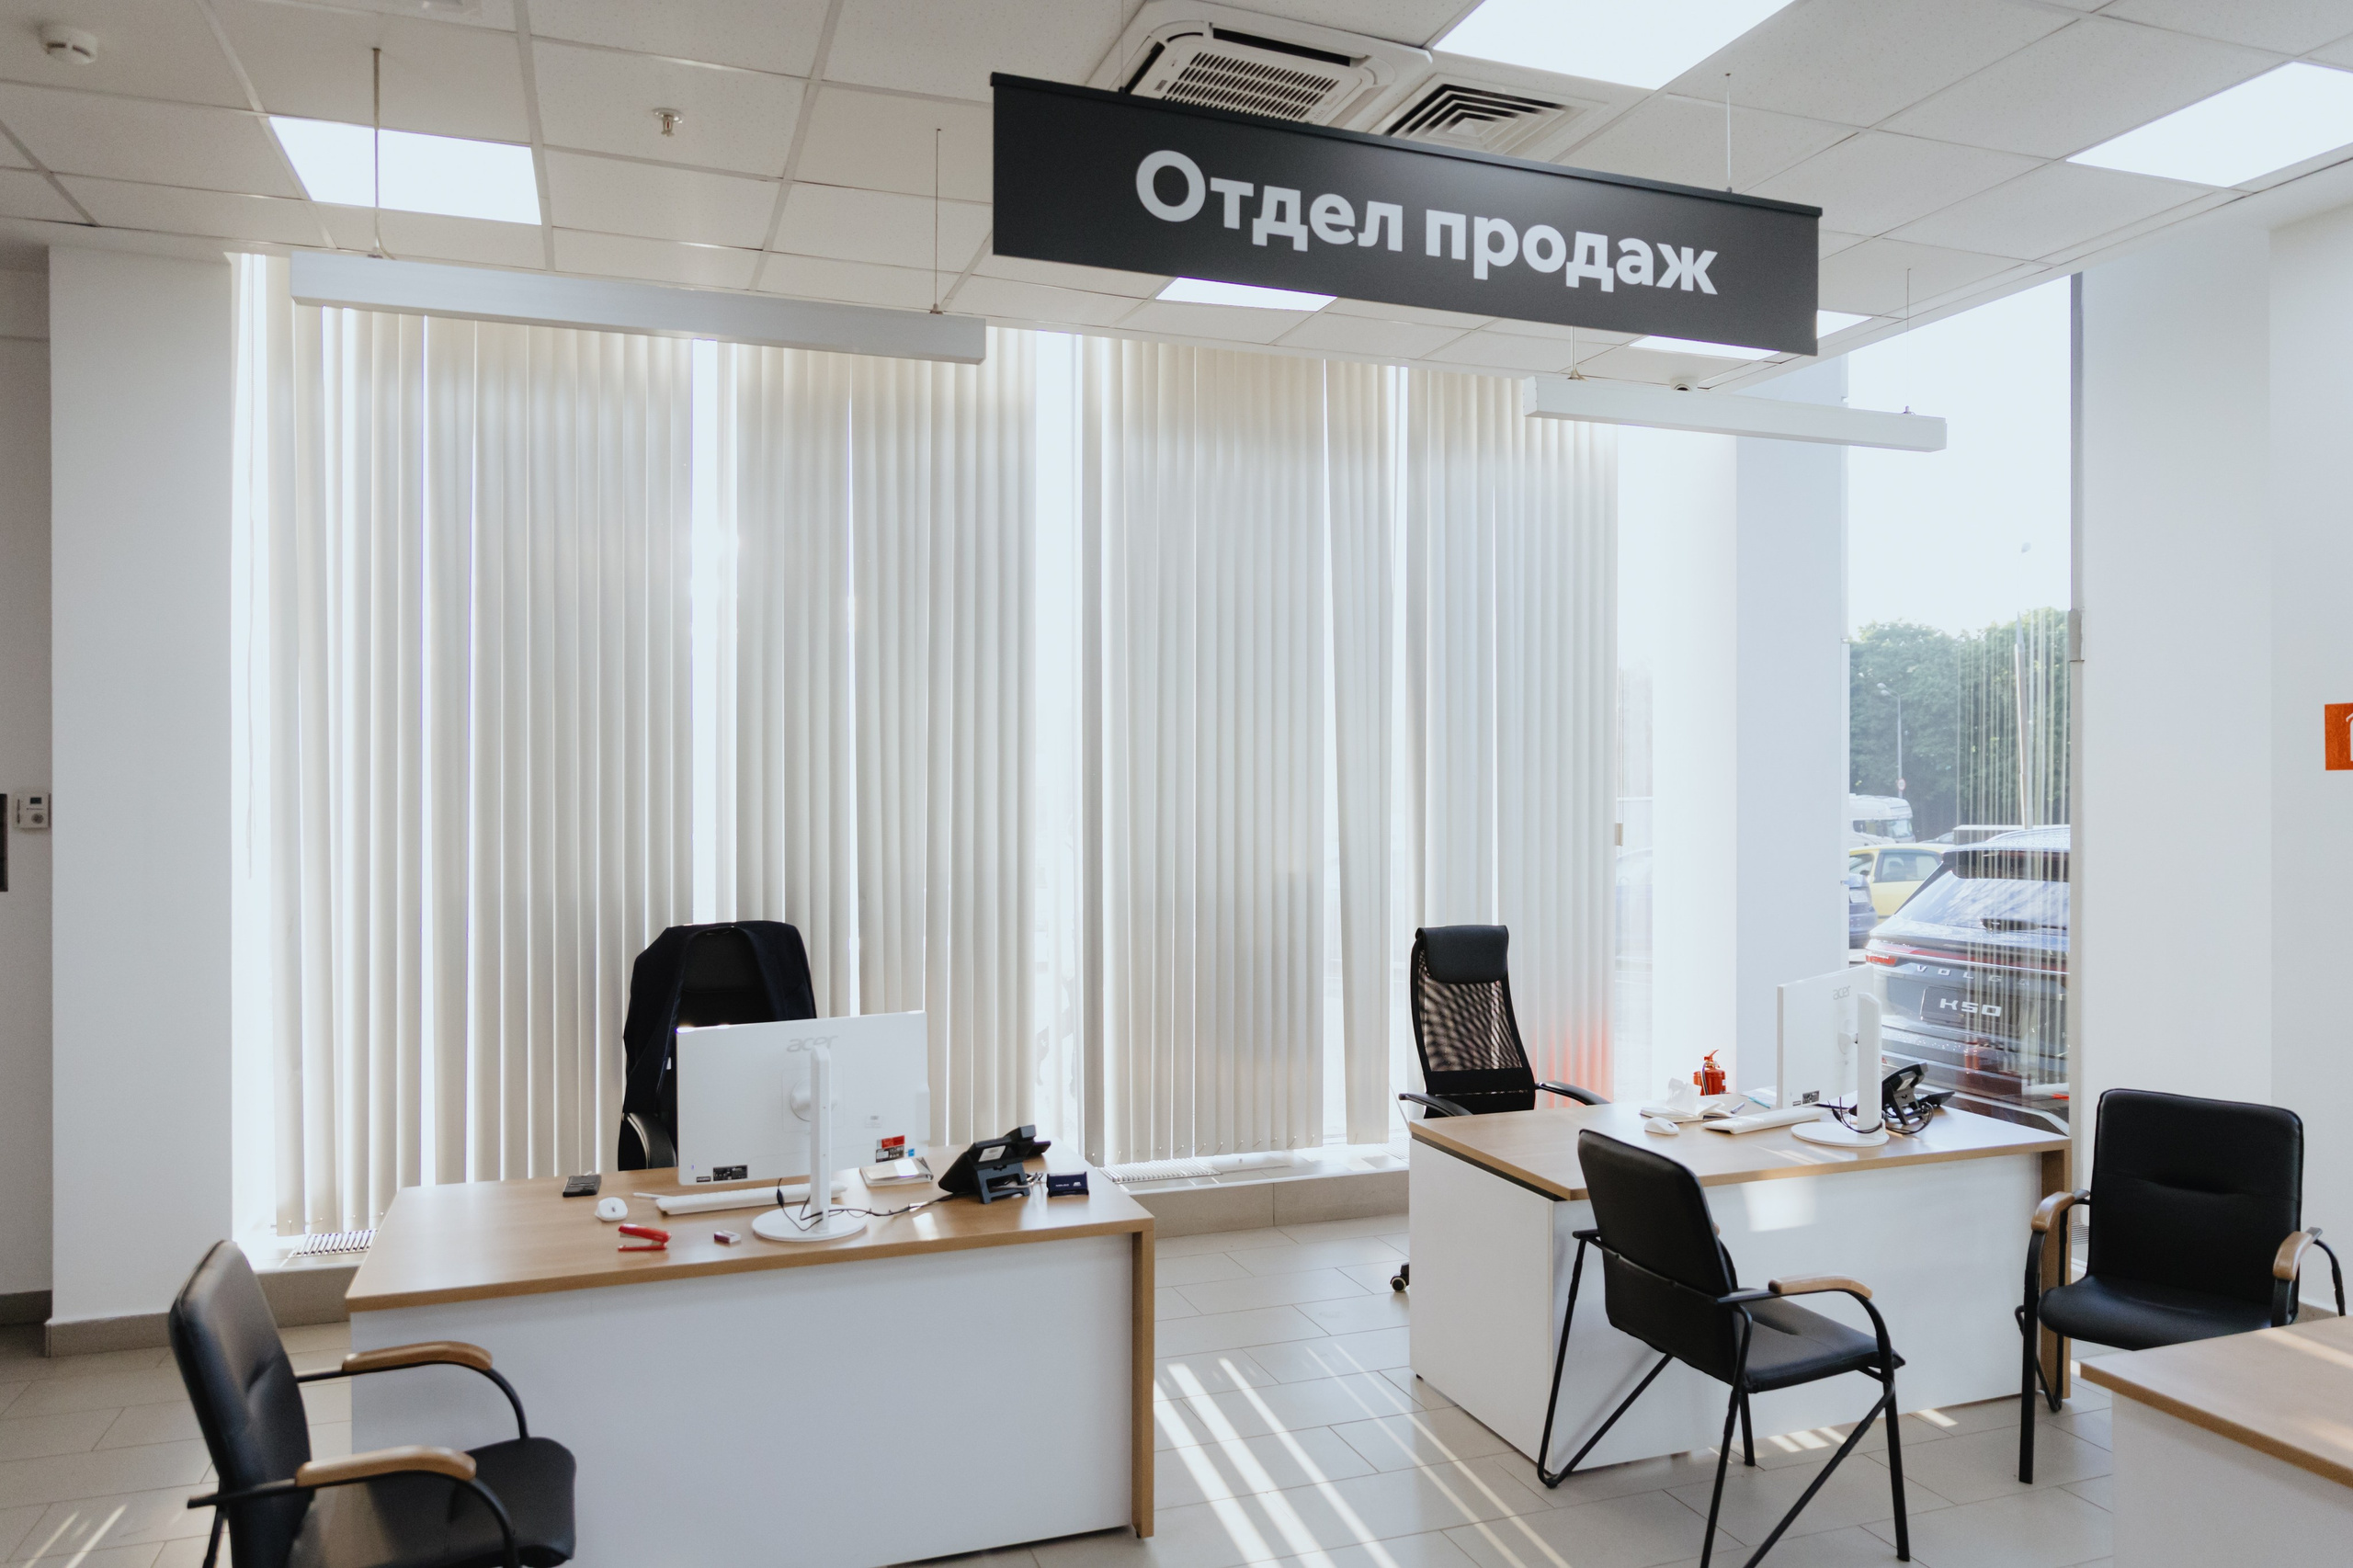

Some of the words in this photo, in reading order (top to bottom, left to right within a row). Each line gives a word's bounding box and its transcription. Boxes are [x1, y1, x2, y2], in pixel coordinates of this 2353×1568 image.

[1136, 150, 1404, 253] Отдел
[1425, 209, 1719, 296] продаж
[1916, 965, 2030, 986] VOLGA
[1833, 985, 1851, 1000] acer
[787, 1035, 838, 1051] acer
